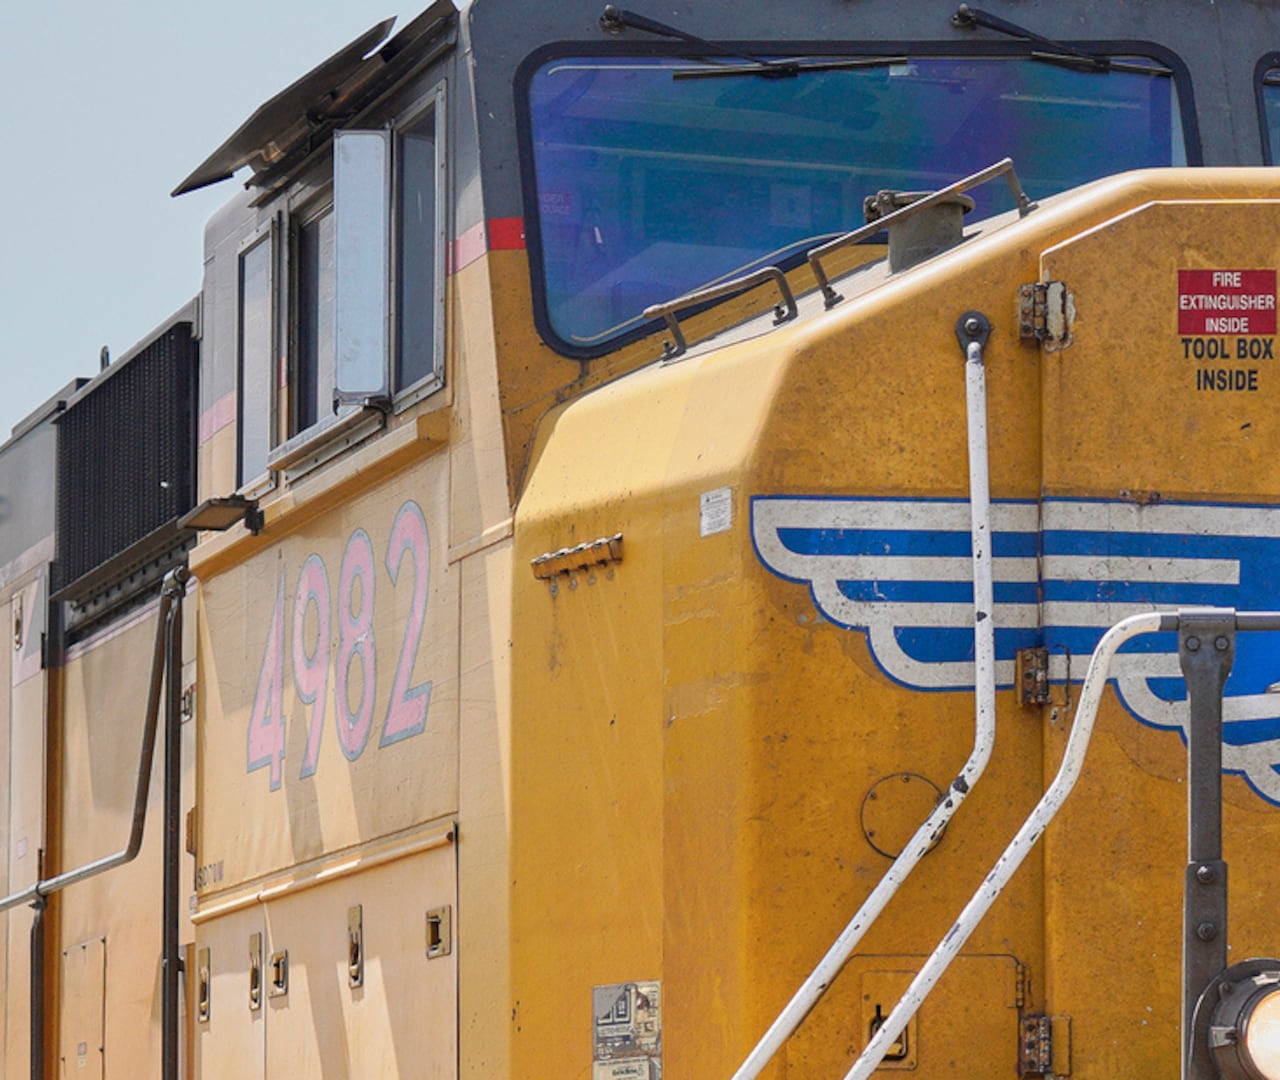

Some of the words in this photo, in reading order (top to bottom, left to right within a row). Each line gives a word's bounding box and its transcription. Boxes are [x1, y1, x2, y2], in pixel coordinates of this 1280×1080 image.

[1212, 271, 1241, 288] FIRE
[1179, 294, 1275, 310] EXTINGUISHER
[1204, 317, 1249, 333] INSIDE
[1181, 338, 1230, 359] TOOL
[1237, 338, 1274, 359] BOX
[1196, 369, 1258, 391] INSIDE
[246, 499, 433, 793] 4982
